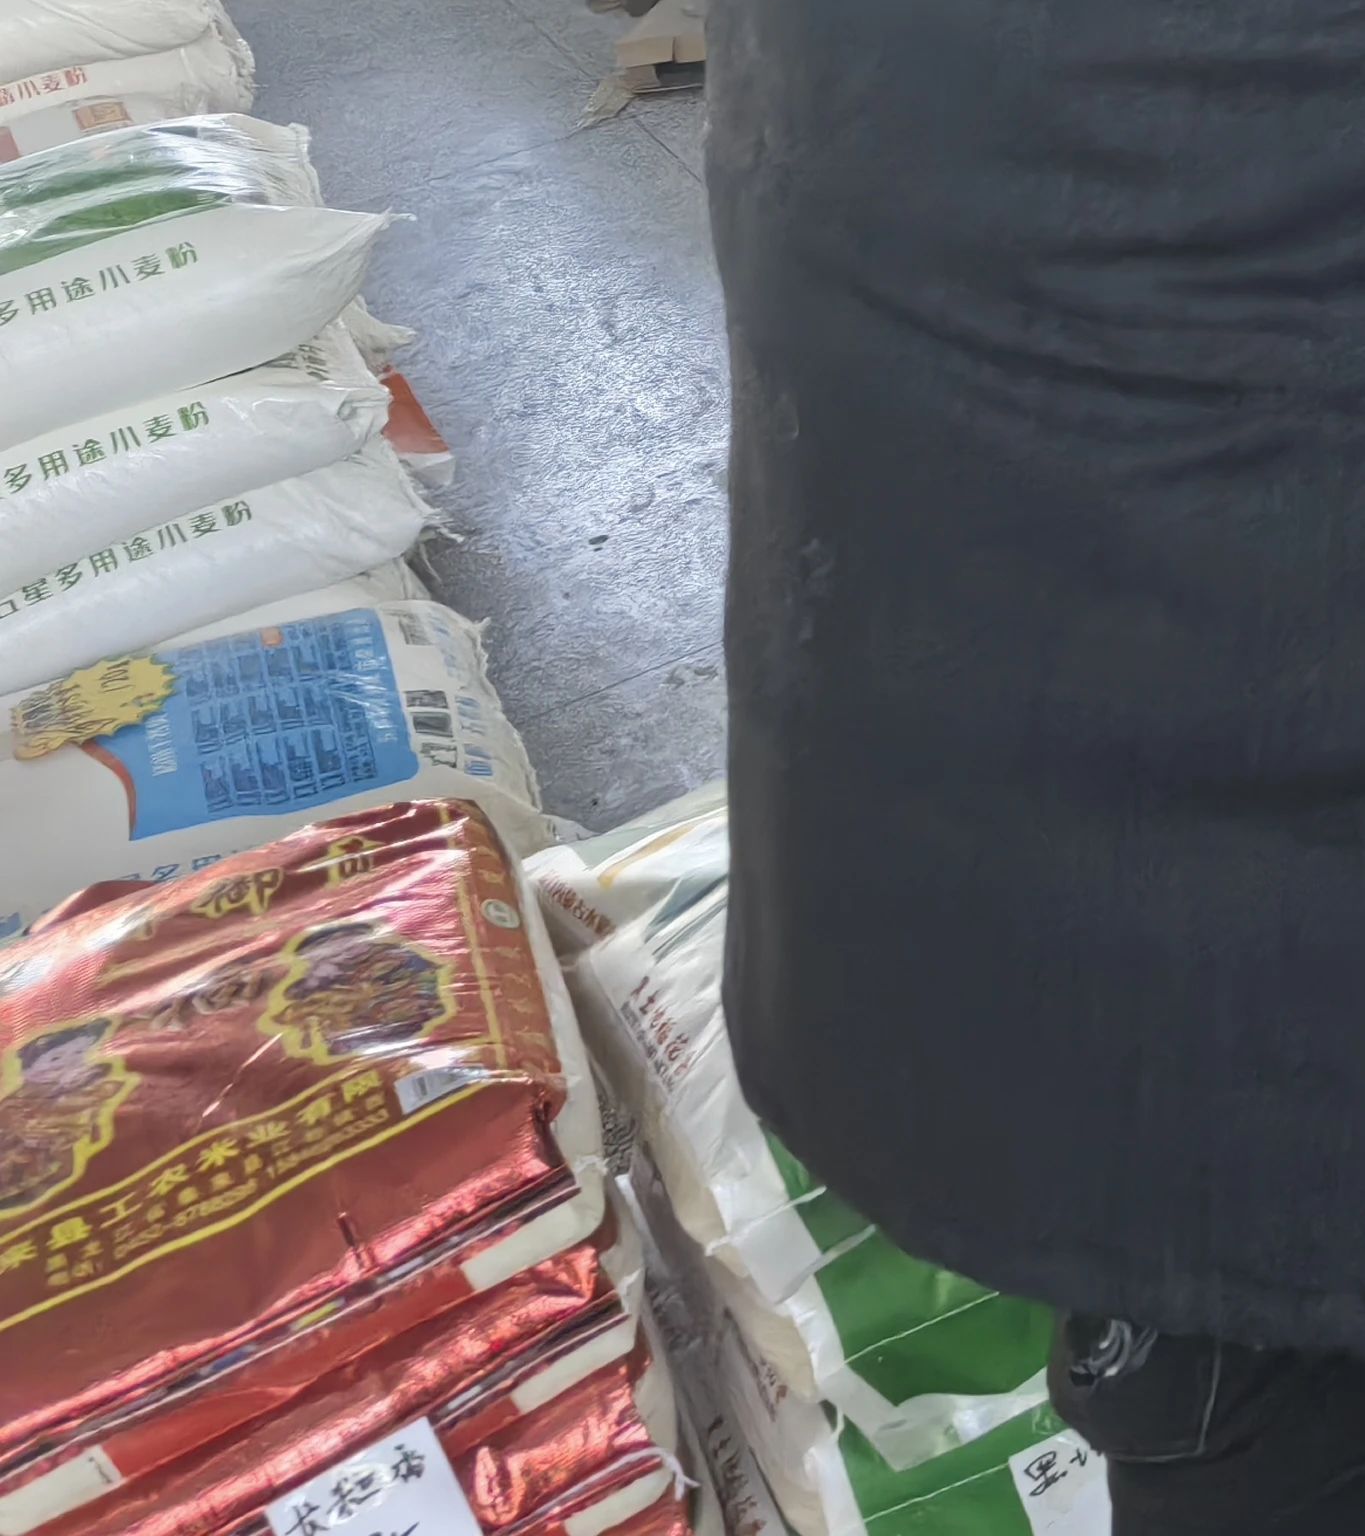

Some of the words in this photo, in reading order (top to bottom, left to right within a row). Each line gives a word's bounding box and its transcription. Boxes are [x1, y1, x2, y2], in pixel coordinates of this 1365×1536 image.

[0, 241, 199, 327] 多用途小麦粉
[3, 400, 210, 495] 多用途小麦粉
